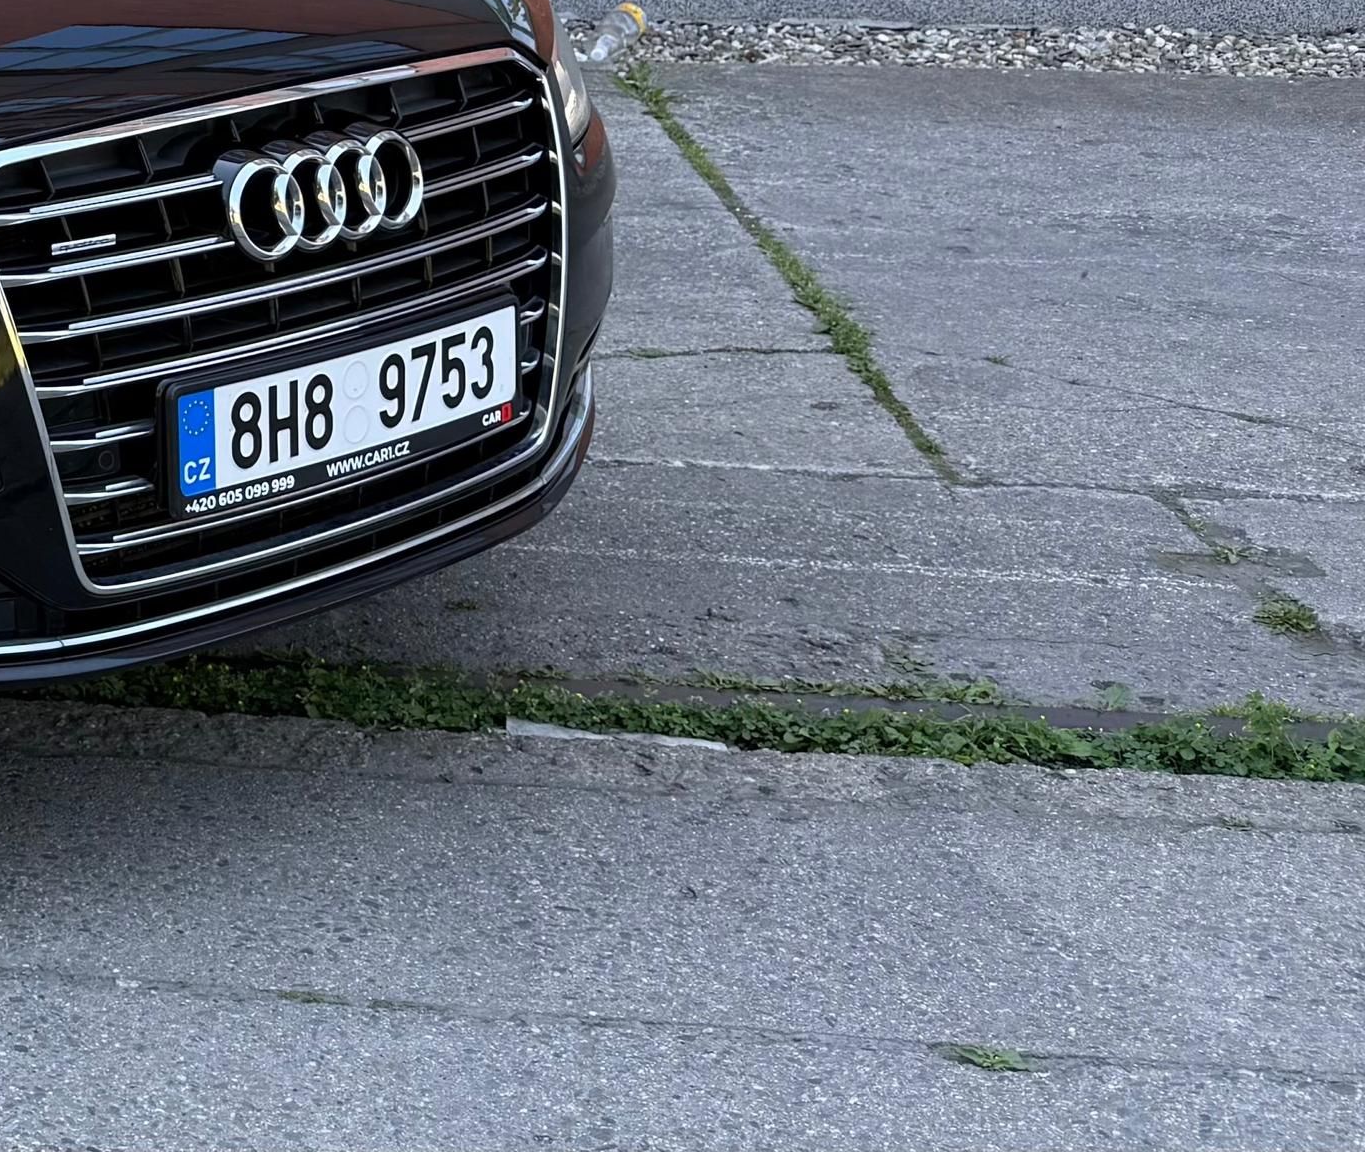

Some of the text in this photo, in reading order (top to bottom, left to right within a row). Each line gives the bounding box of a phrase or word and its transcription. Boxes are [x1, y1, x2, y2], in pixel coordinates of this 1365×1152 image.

[230, 326, 494, 470] 8H8 9753
[183, 456, 211, 484] CZ
[326, 440, 410, 477] WWW.CAR1.CZ
[185, 475, 295, 513] +420 605 099 999
